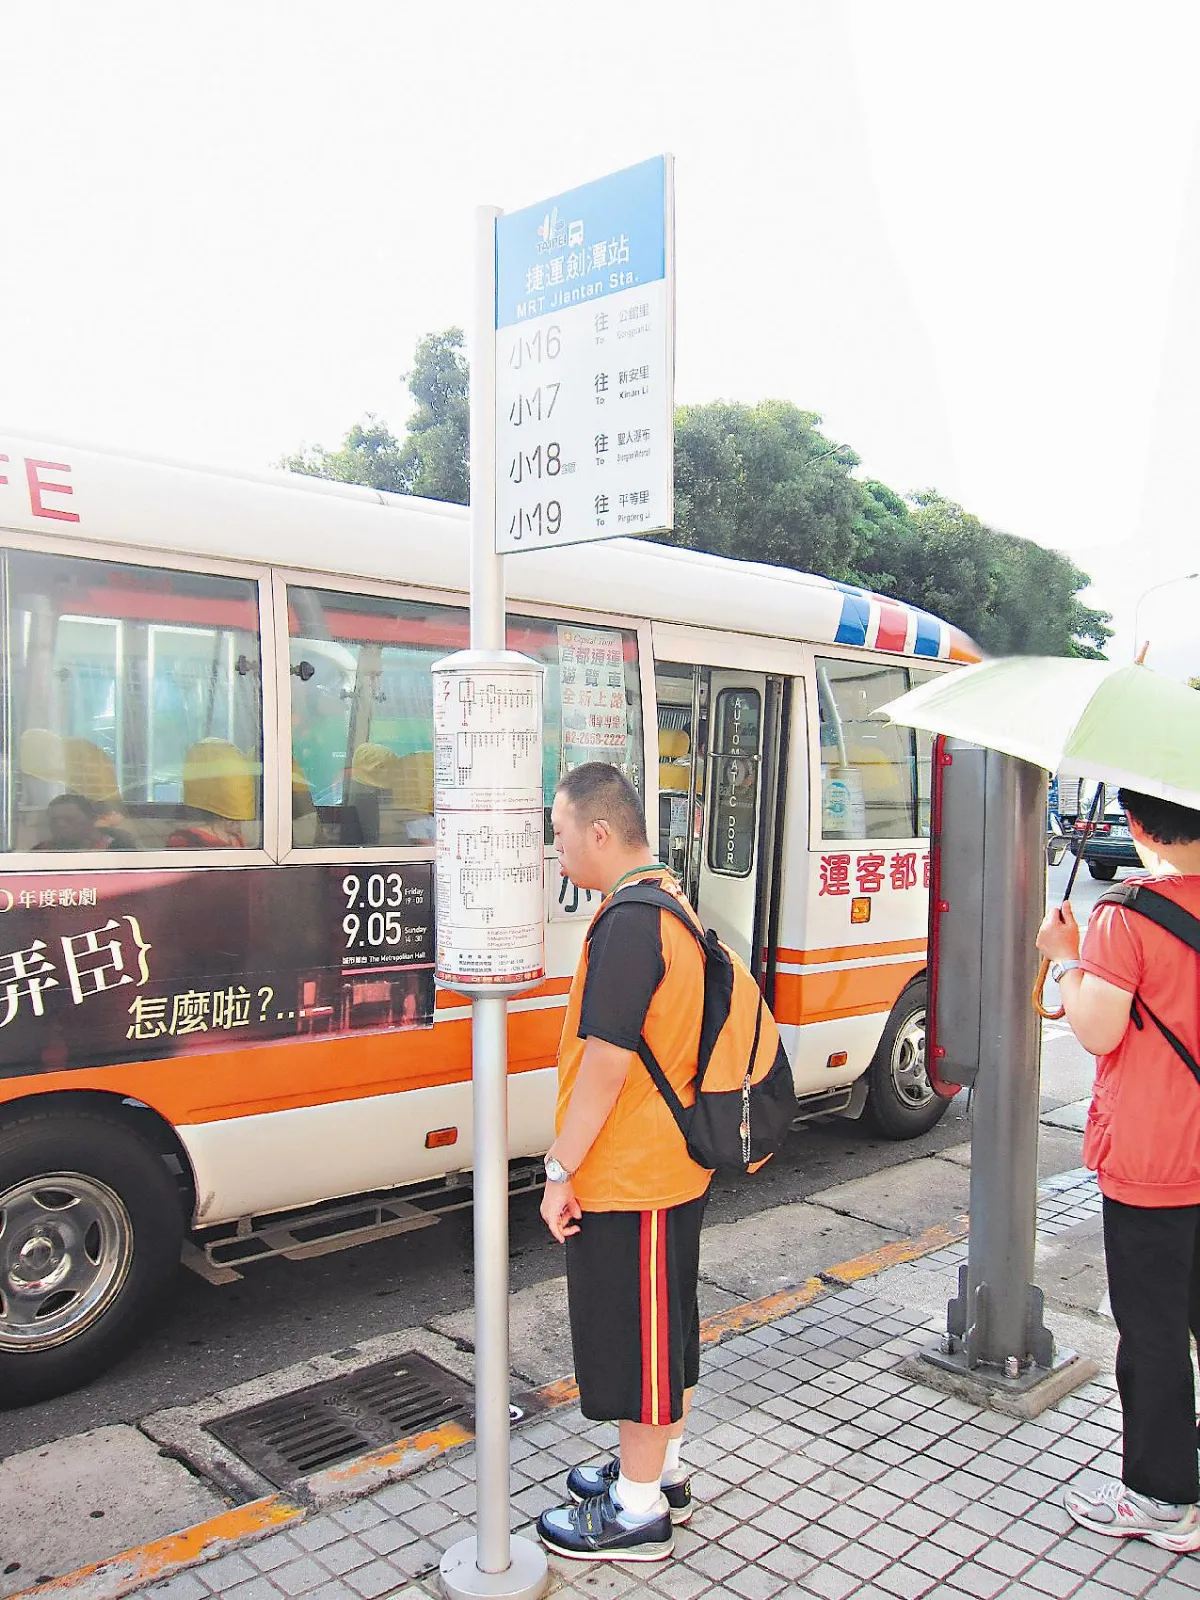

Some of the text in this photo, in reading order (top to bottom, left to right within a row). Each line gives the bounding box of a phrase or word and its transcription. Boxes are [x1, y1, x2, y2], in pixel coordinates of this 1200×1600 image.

[536, 235, 567, 254] TAIPEI
[525, 233, 630, 295] 捷運劍潭站
[516, 270, 639, 318] MRT Jiantan Sta.
[594, 312, 609, 333] 往
[510, 325, 562, 370] 小16
[594, 365, 650, 393] 往 新安里
[510, 382, 562, 427] 小17
[595, 396, 605, 405] To
[594, 433, 609, 454] 往
[595, 457, 605, 466] To
[510, 442, 562, 484] 小18
[0, 454, 80, 523] E
[594, 489, 650, 514] 往 平等里
[510, 500, 562, 541] 小19
[595, 518, 605, 526] To
[726, 815, 736, 864] DOOR
[342, 873, 424, 909] 9.03 Friday
[818, 852, 930, 896] 運客都
[342, 911, 428, 948] 9.05 Sunday
[369, 955, 380, 963] The
[380, 952, 414, 962] Metropolitan
[414, 951, 426, 959] Hall
